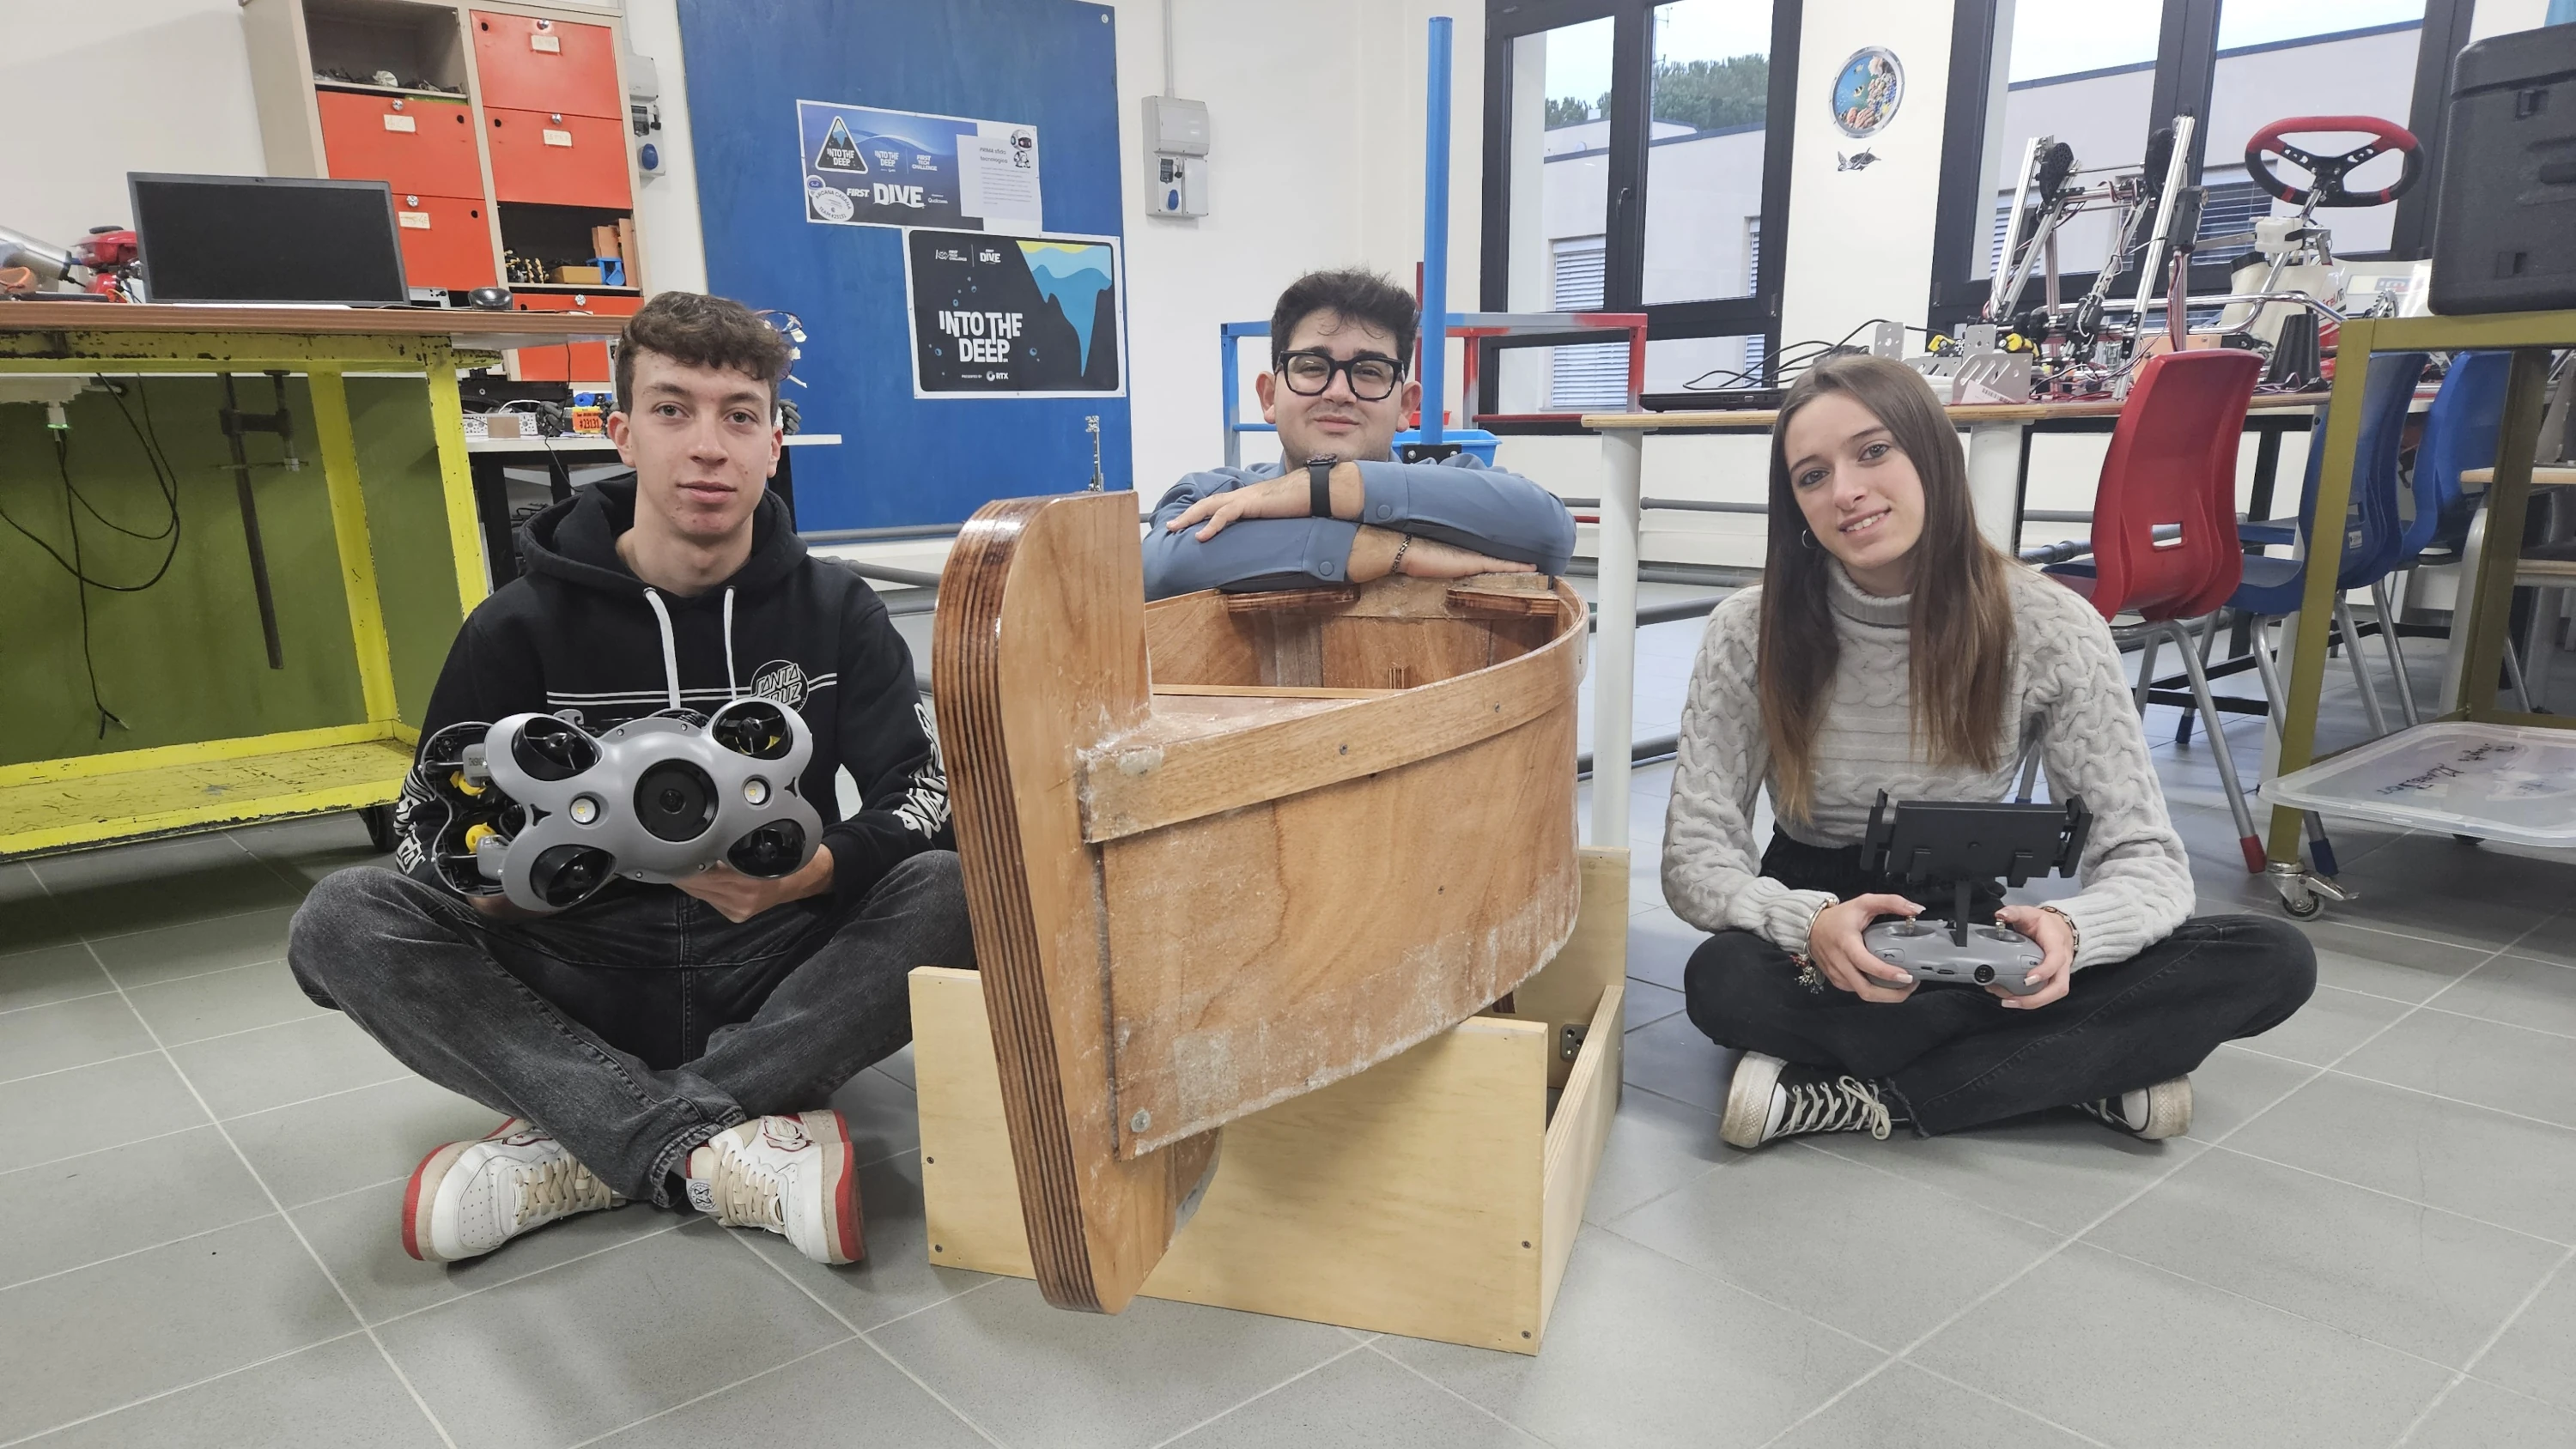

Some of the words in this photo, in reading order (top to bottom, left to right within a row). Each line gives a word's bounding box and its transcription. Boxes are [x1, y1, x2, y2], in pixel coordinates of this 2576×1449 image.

[827, 149, 841, 158] INTO
[841, 149, 854, 159] THE
[874, 150, 887, 159] INTO
[887, 151, 899, 161] THE
[834, 157, 851, 166] DEEP
[816, 190, 834, 199] ARCANA
[847, 188, 870, 197] FIRST
[873, 183, 925, 208] DIVE
[818, 206, 831, 216] TEAM
[980, 252, 1001, 263] DIVE
[939, 310, 985, 337] INTO
[985, 312, 1024, 344] THE
[958, 338, 1011, 363] DEEP
[995, 372, 1009, 380] RTX
[580, 418, 600, 428] #23131
[751, 663, 802, 697] SANTA
[765, 682, 802, 706] RUZ
